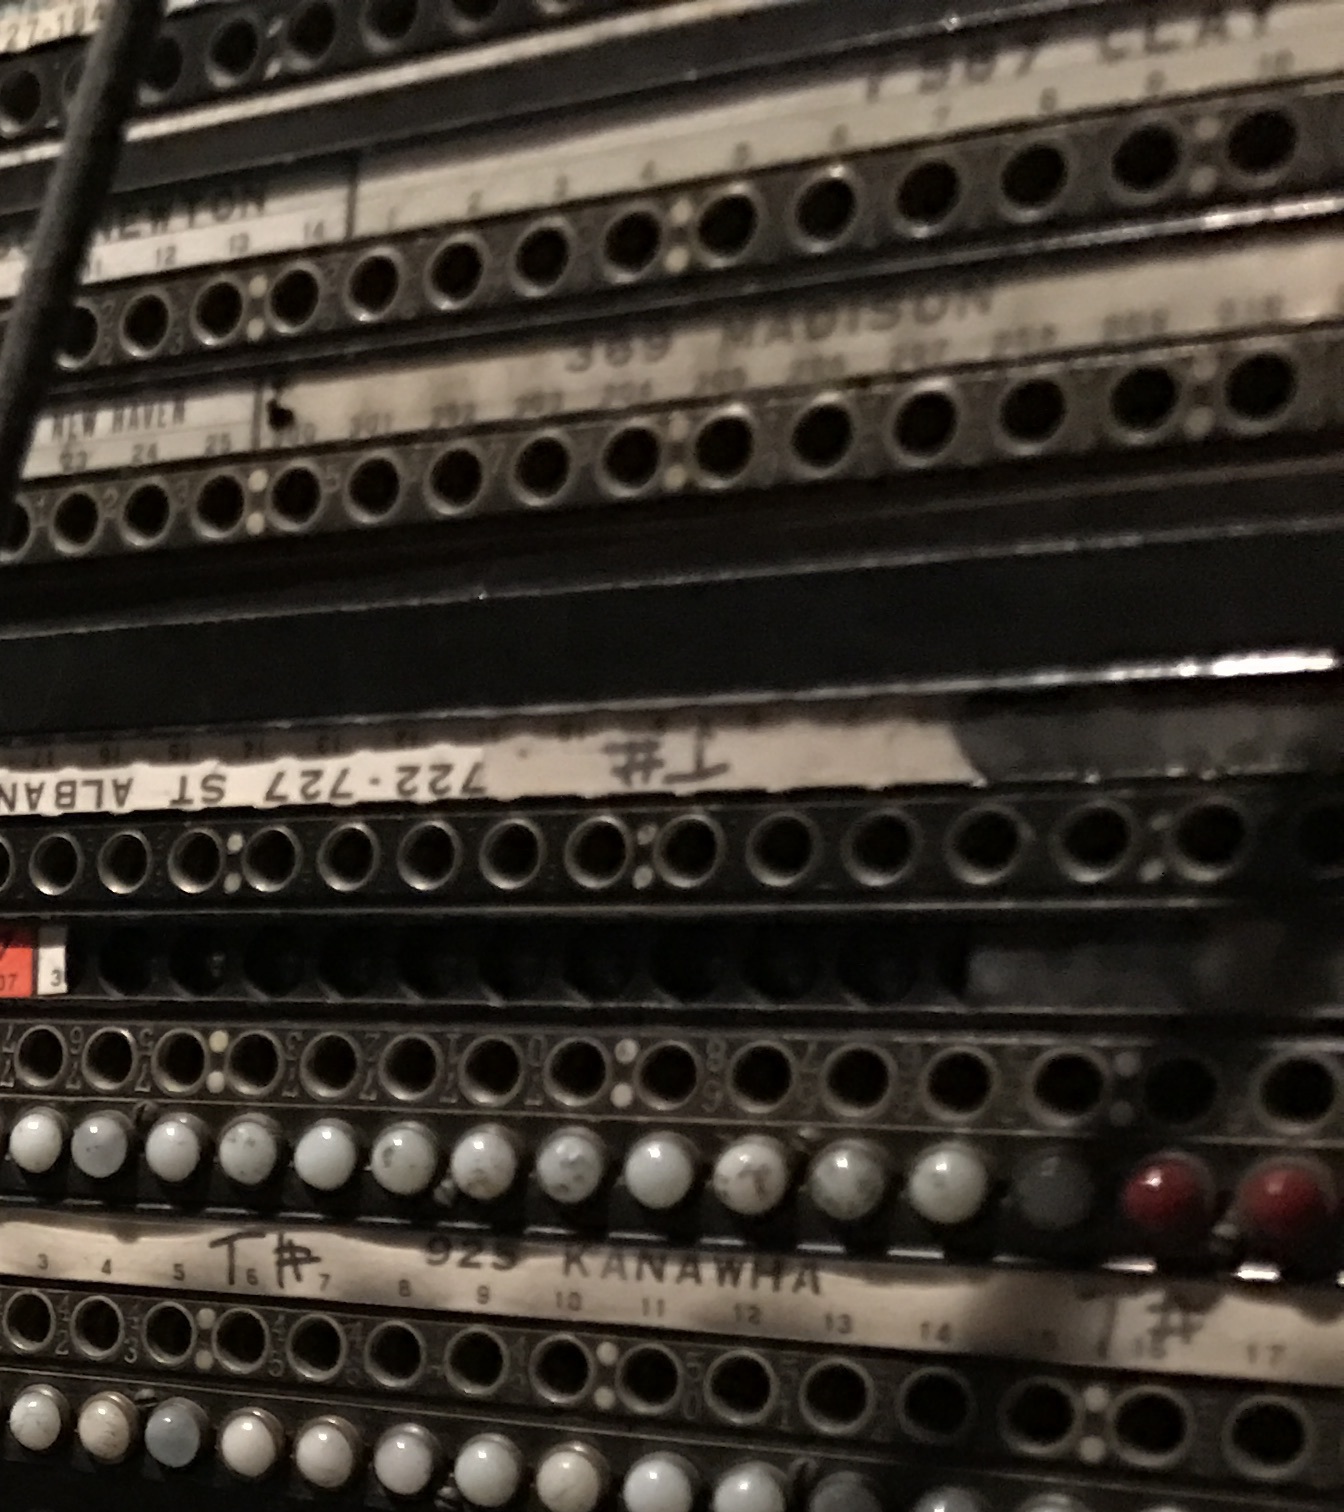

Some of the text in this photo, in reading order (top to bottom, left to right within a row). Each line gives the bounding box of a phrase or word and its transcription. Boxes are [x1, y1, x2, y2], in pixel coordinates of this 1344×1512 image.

[155, 246, 177, 266] 12
[719, 290, 997, 353] MADISON
[176, 771, 227, 805] ST
[263, 759, 489, 802] 722-727
[562, 1244, 823, 1296] KANAWHA
[556, 1290, 583, 1313] 10
[642, 1297, 665, 1318] 11
[734, 1303, 762, 1325] 12
[824, 1311, 854, 1335] 13
[920, 1319, 952, 1344] 14
